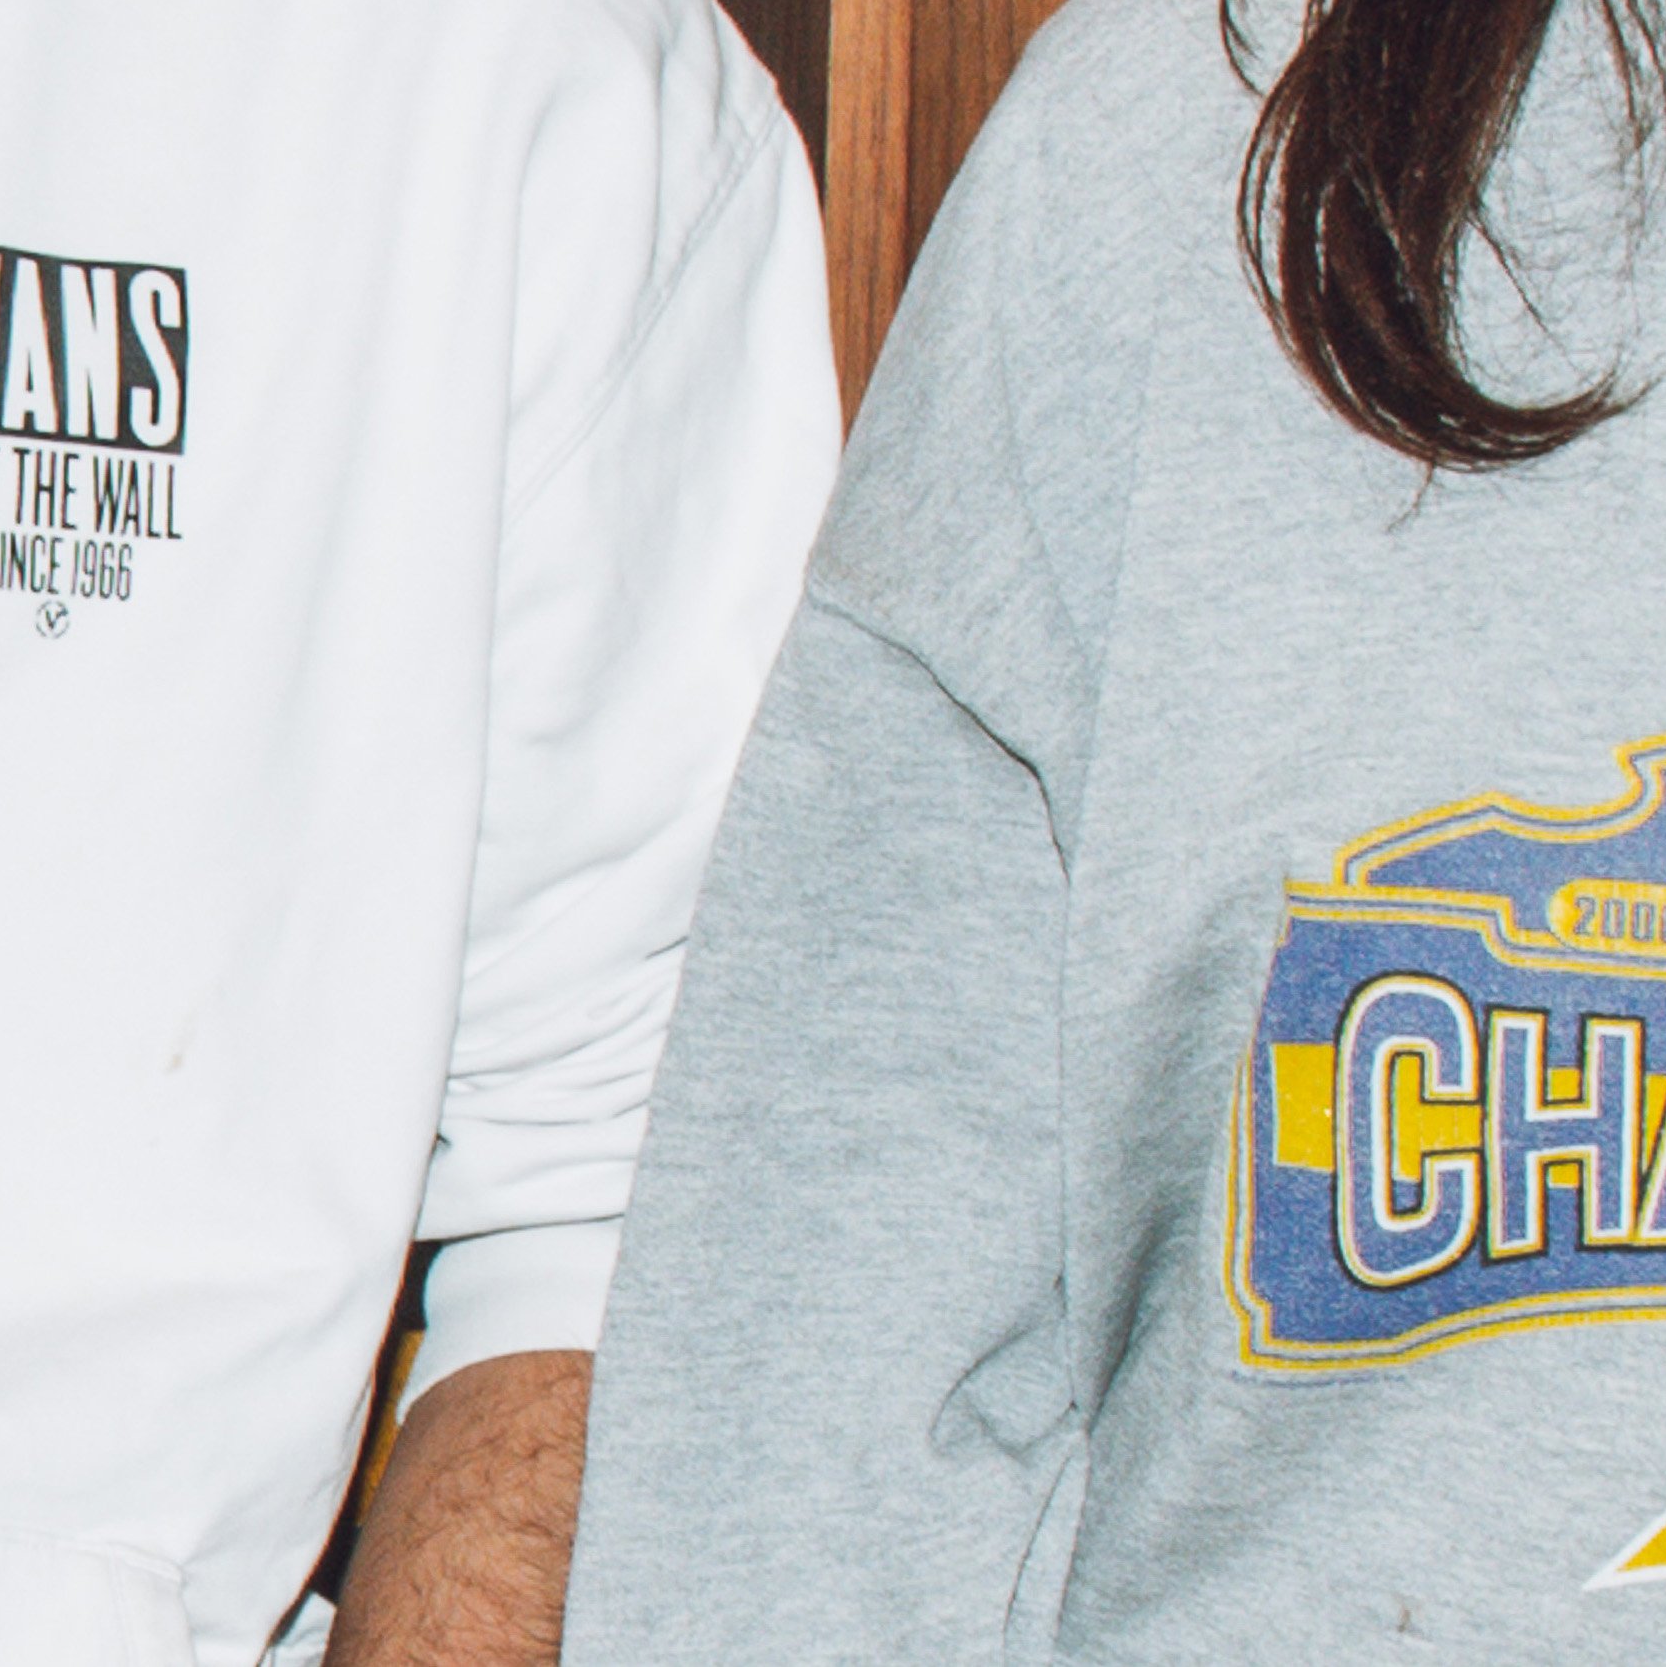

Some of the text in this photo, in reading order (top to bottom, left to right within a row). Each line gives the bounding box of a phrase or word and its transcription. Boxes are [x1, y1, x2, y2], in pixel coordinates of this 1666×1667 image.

[13, 446, 80, 530] THE
[93, 454, 183, 540] WALL
[70, 540, 132, 601] 1966
